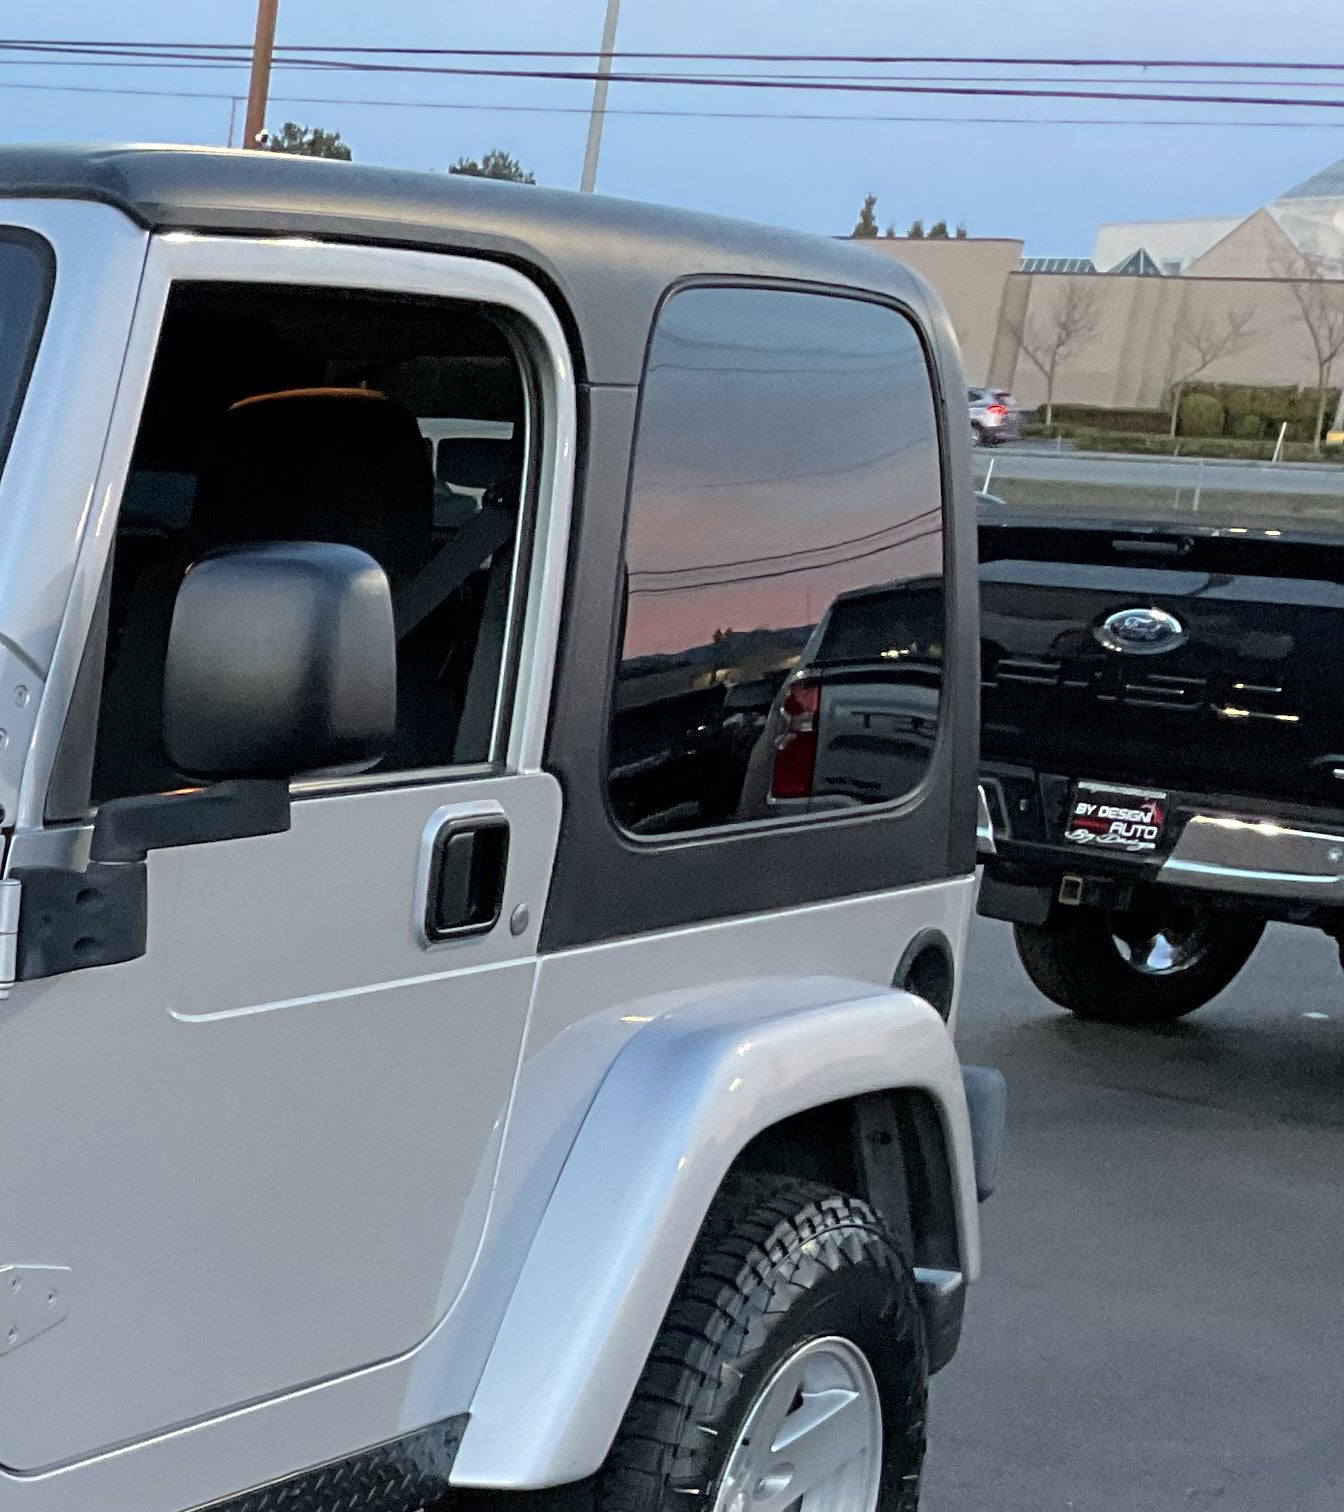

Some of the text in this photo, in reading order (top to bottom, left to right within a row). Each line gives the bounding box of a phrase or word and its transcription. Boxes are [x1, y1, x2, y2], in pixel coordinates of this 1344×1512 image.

[1074, 803, 1153, 823] BY DESIGN
[1109, 821, 1158, 840] AUTO
